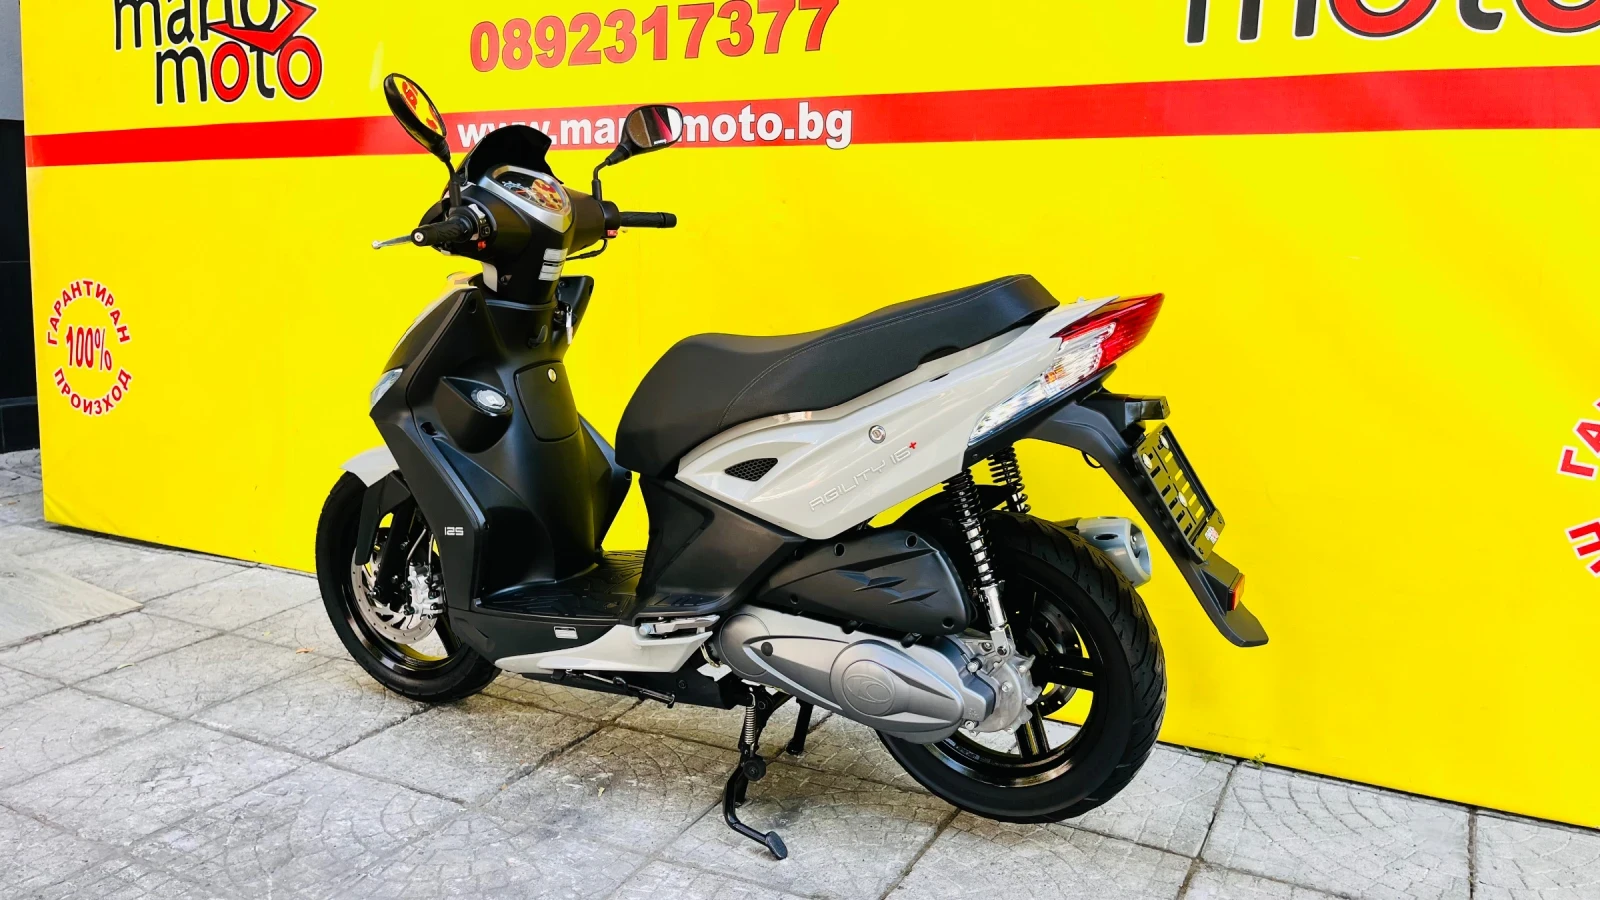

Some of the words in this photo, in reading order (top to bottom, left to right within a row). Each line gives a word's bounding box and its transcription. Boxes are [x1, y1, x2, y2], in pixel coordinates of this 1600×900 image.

[470, 0, 840, 72] 0892317377
[156, 36, 323, 104] moto
[457, 102, 853, 150] w.mamoto.bg
[47, 280, 131, 345] ГАРАНТИРАН
[66, 326, 112, 371] 100%
[54, 368, 132, 415] ПРОИЗХОД
[808, 460, 886, 511] AGILITY
[444, 526, 465, 536] 125
